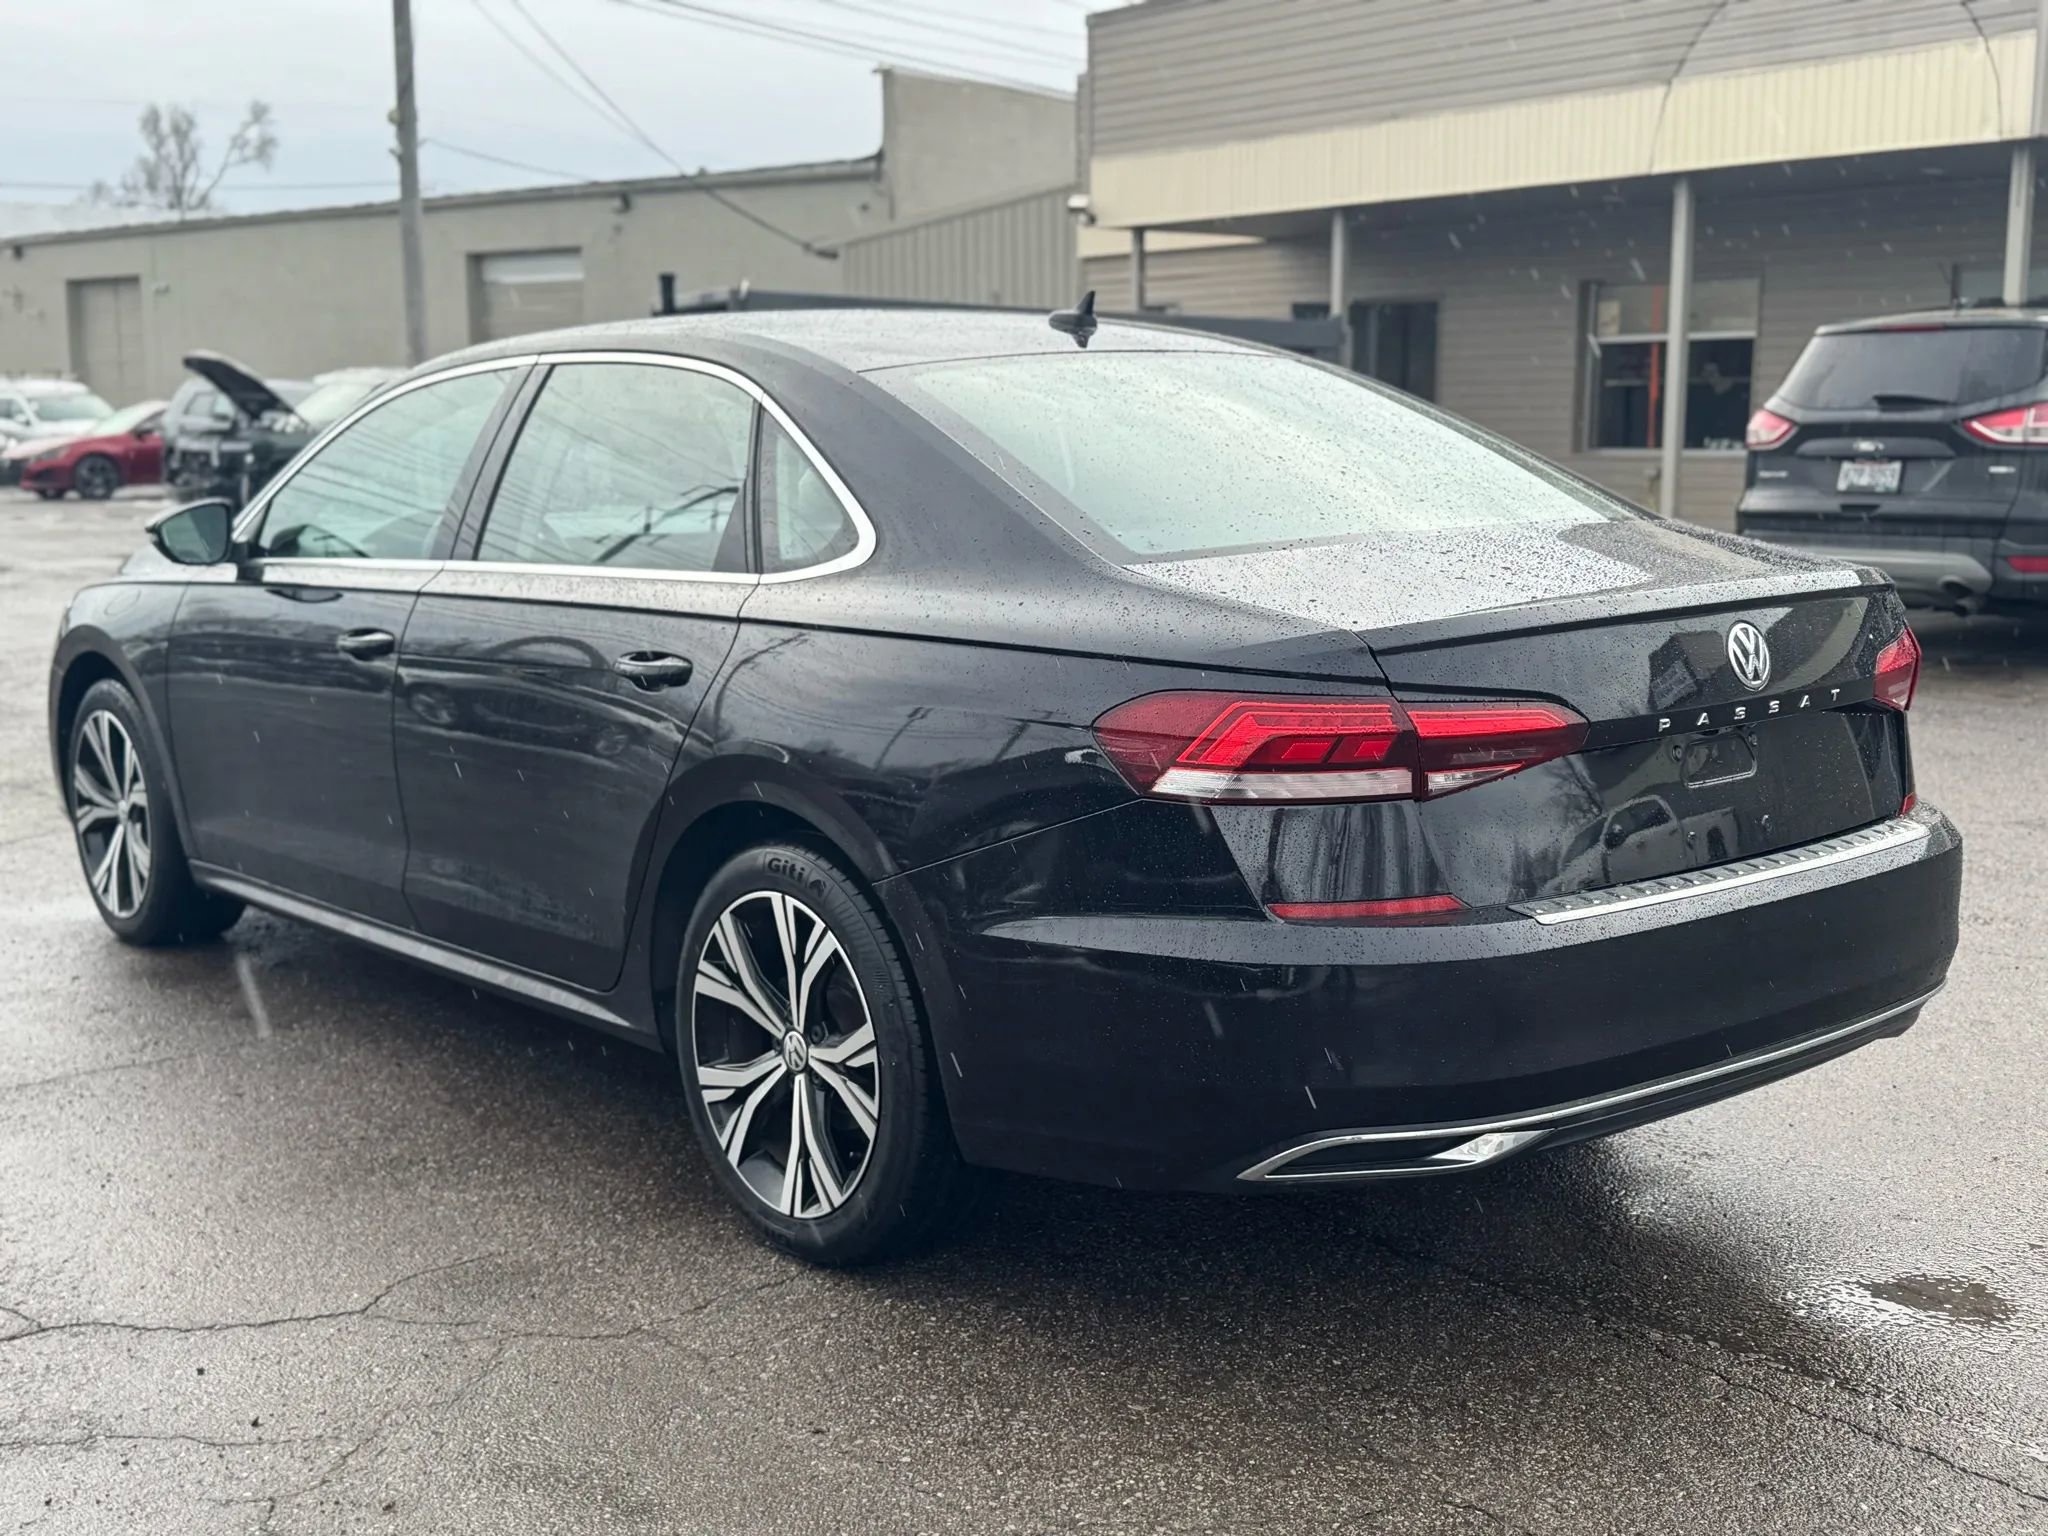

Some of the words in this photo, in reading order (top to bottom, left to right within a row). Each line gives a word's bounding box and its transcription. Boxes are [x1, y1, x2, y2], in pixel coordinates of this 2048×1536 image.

[1728, 622, 1770, 690] VW
[1658, 688, 1840, 732] PASSAT
[767, 858, 805, 881] Giti
